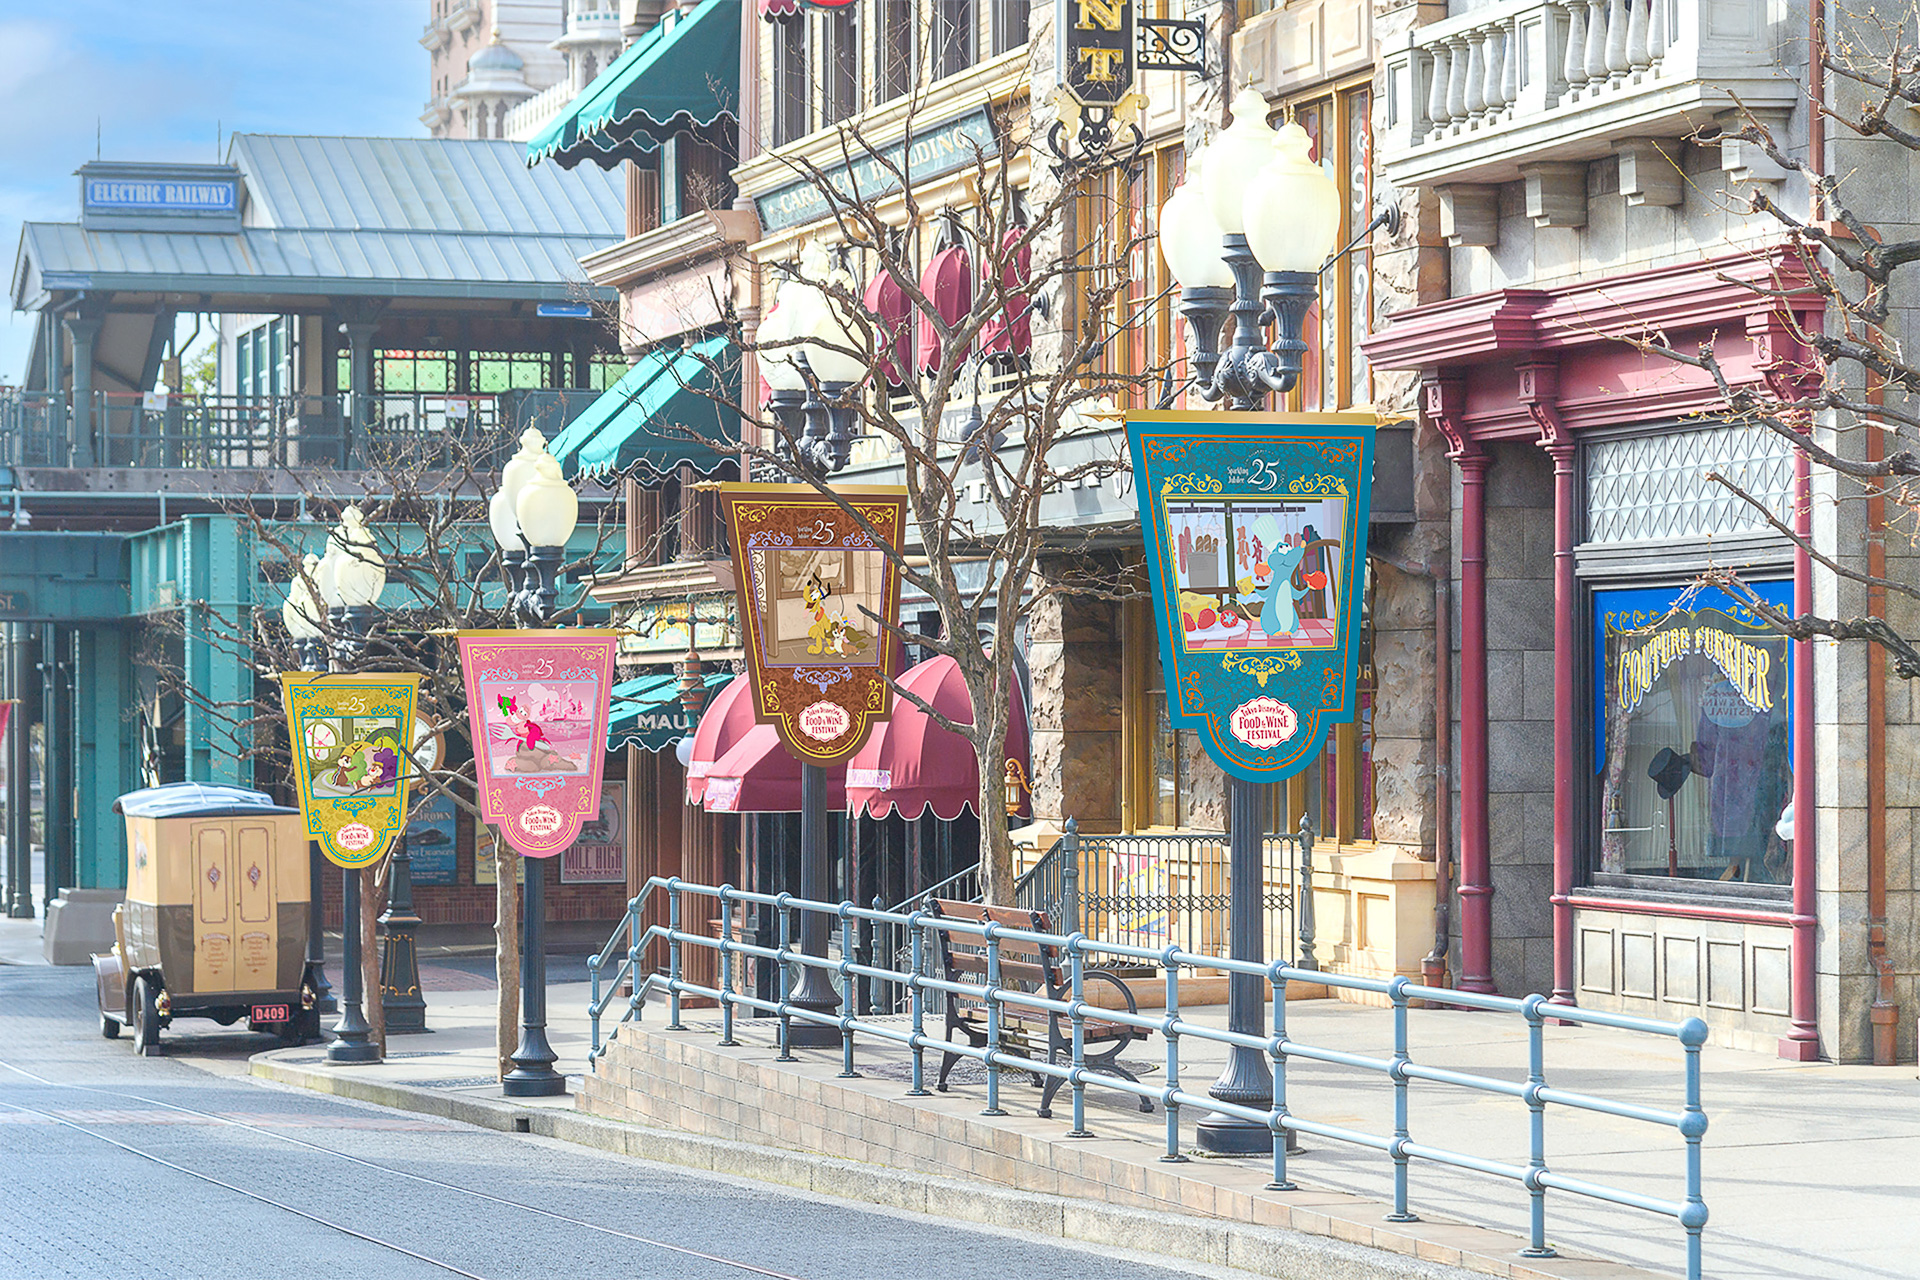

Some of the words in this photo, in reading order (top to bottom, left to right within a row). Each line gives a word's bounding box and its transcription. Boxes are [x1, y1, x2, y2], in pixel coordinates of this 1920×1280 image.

[93, 183, 161, 203] ELECTRIC
[165, 184, 227, 204] RAILWAY
[1227, 466, 1249, 476] Sparkling
[1247, 458, 1280, 491] 25
[812, 519, 836, 545] 25
[534, 657, 555, 678] 25
[1618, 627, 1690, 713] COUTURE
[1694, 625, 1774, 713] FURRIER
[348, 696, 367, 714] 25
[1240, 707, 1258, 717] Tokyo
[1257, 704, 1285, 716] DisneySea
[637, 713, 702, 730] MAU
[806, 715, 822, 726] FOOD
[826, 715, 843, 725] WINE
[1239, 716, 1261, 729] FOOD
[1265, 715, 1289, 728] WINE
[811, 726, 838, 734] FESTIVAL
[1247, 729, 1282, 740] FESTIVAL
[525, 816, 539, 825] FOOD
[542, 815, 557, 824] WINE
[595, 846, 622, 869] HIGH
[255, 1007, 285, 1020] D409
